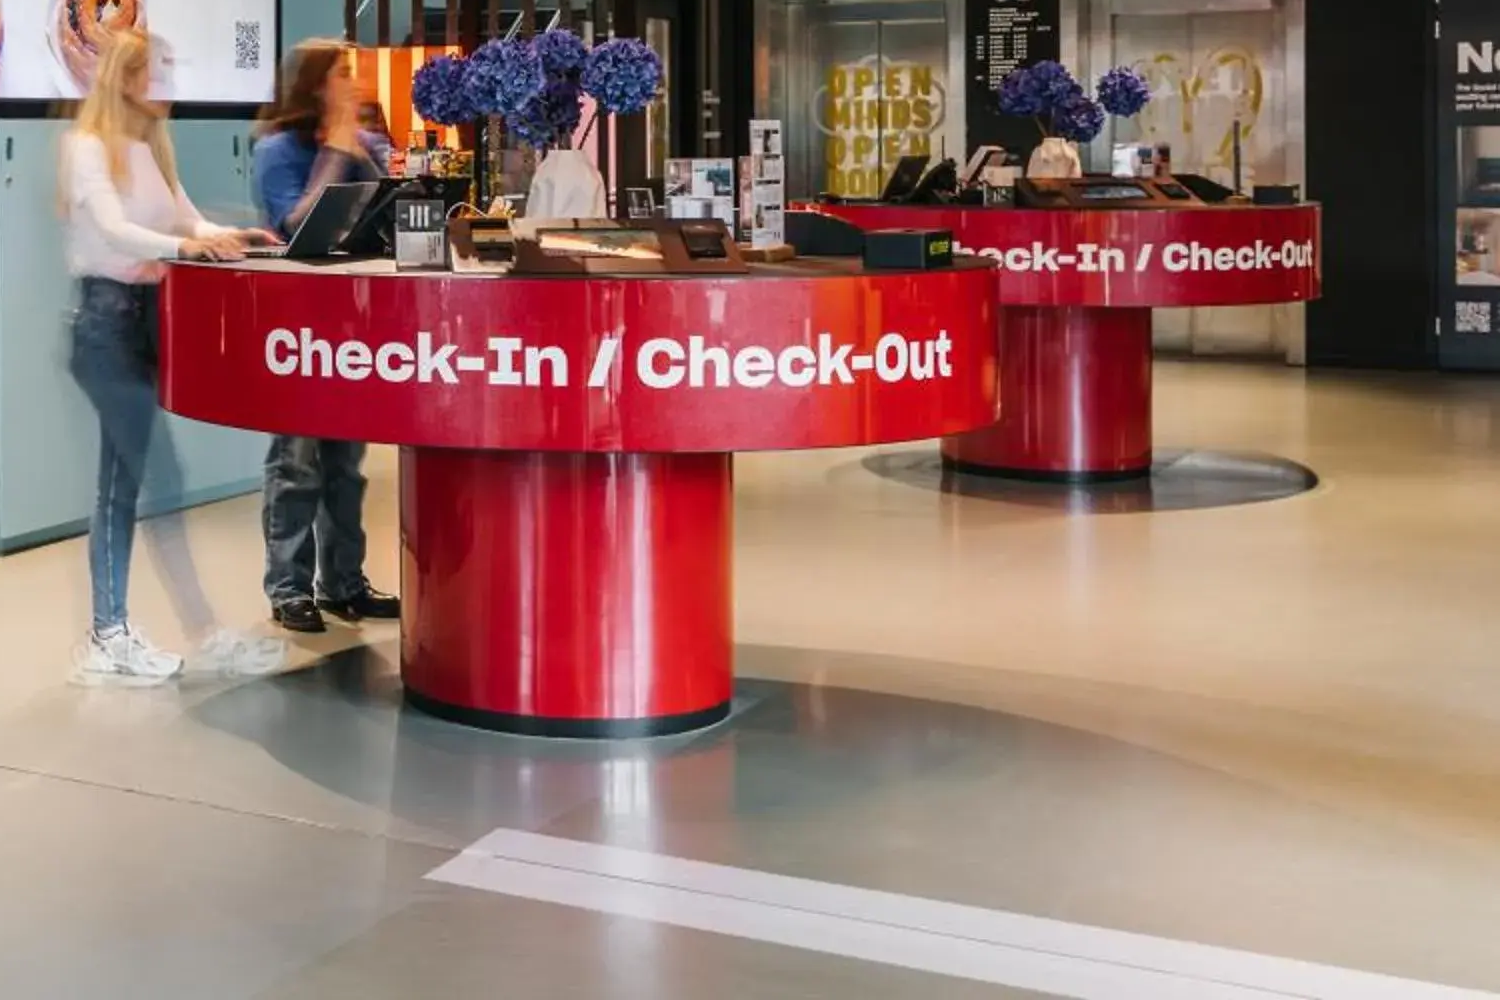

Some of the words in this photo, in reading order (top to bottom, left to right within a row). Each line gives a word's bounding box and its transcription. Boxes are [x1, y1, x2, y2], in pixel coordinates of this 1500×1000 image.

[828, 66, 931, 98] OPEN
[826, 99, 932, 130] MINDS
[827, 134, 931, 166] OPEN
[1162, 239, 1313, 272] Check-Out
[265, 327, 569, 387] Check-In
[587, 337, 619, 388] /
[636, 329, 953, 389] Check-Out
